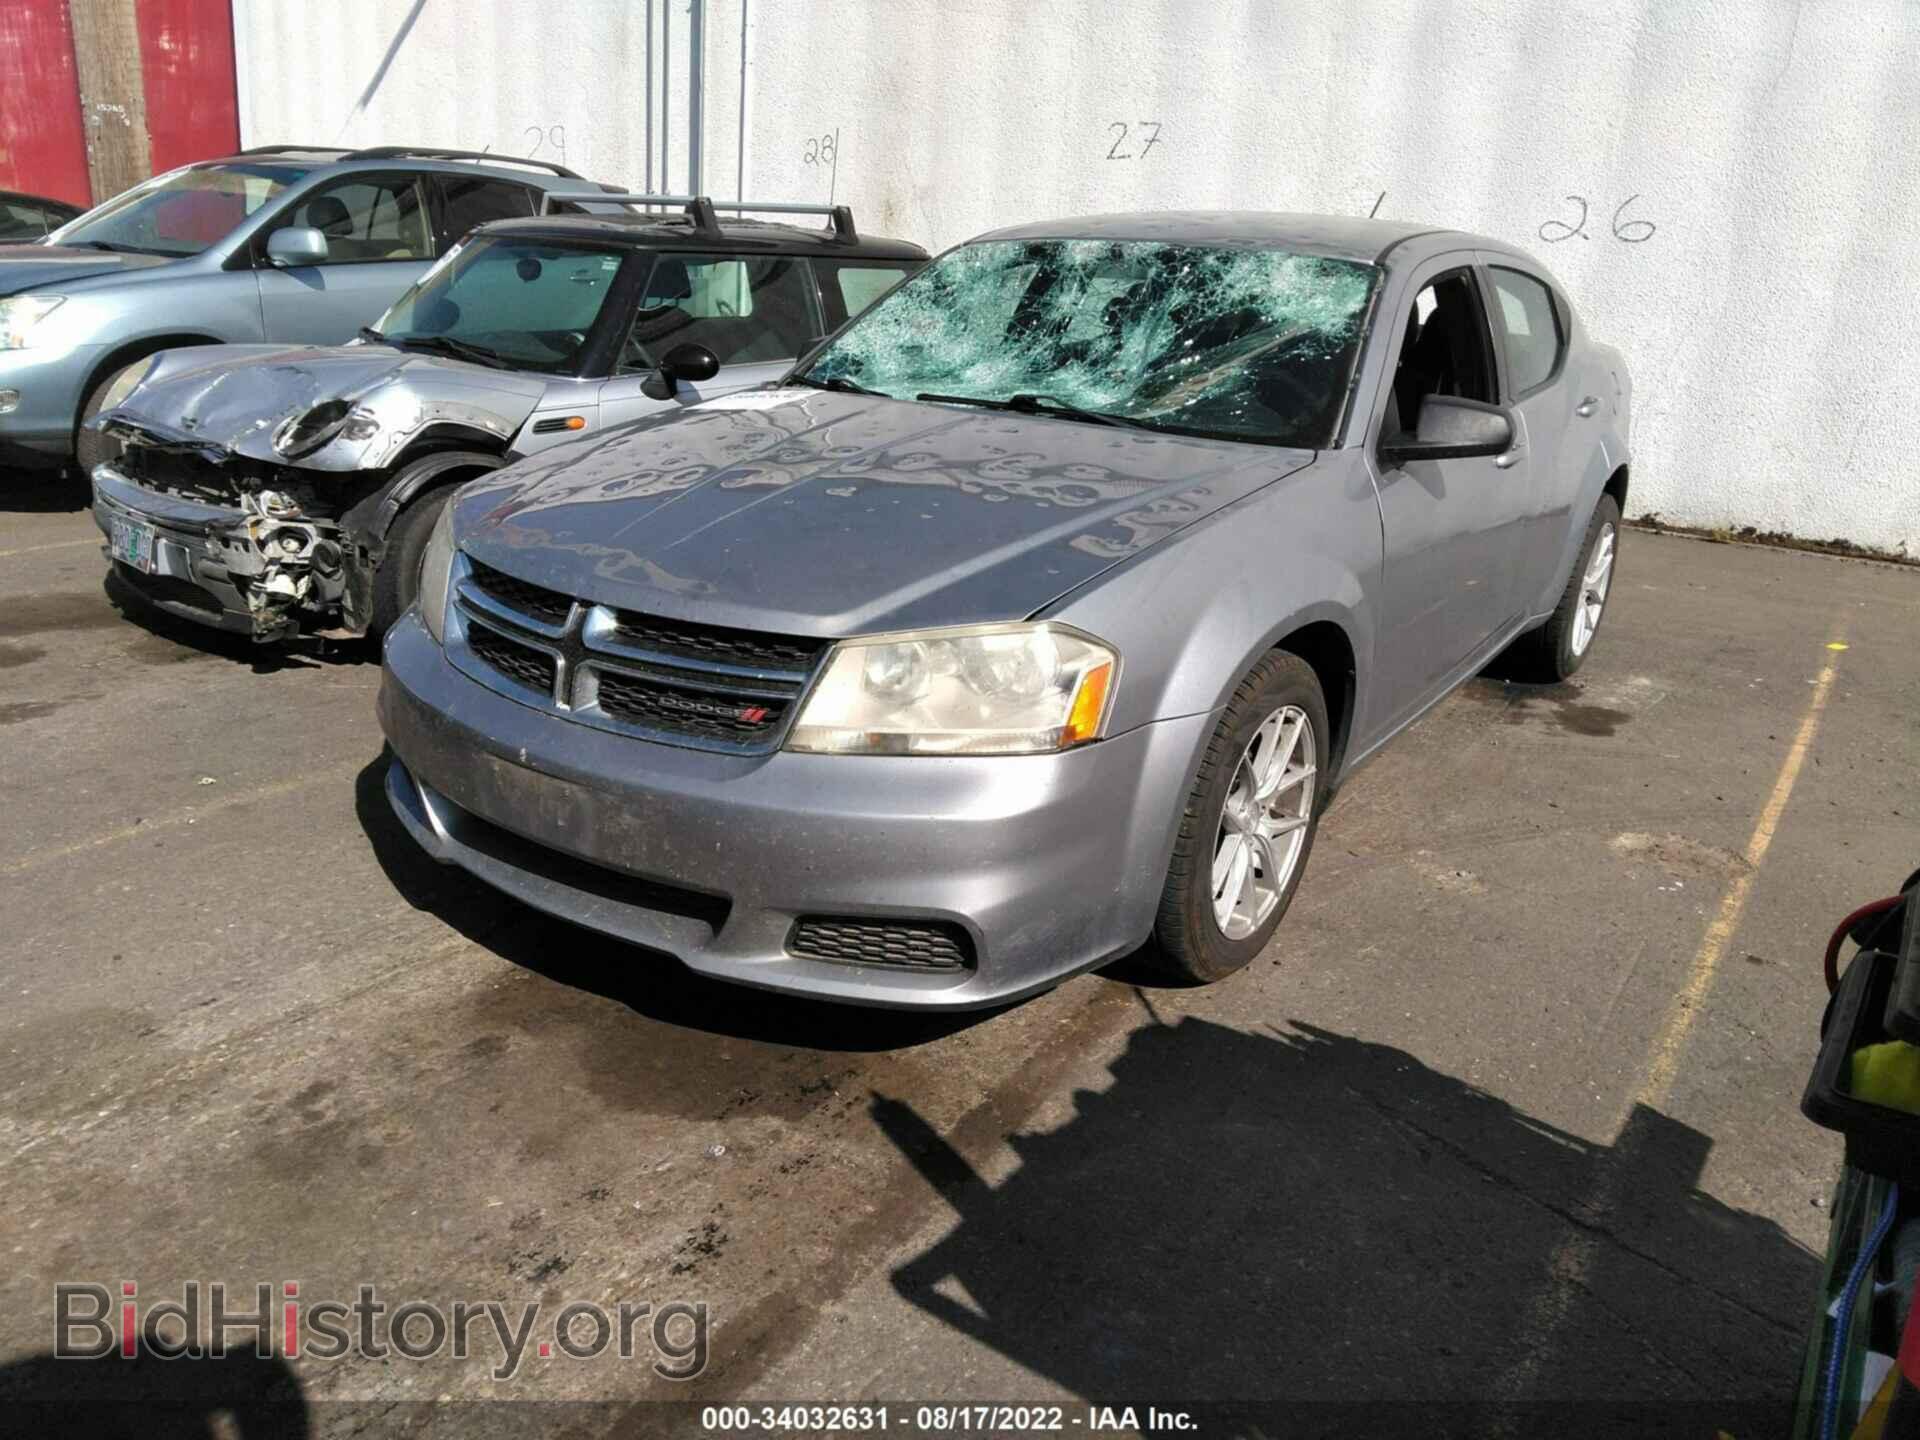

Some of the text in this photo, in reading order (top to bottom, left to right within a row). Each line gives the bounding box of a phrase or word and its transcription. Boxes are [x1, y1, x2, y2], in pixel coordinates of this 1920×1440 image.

[523, 124, 567, 166] 29
[804, 134, 834, 167] 28
[1106, 121, 1162, 160] 27
[1539, 193, 1656, 243] 26
[659, 696, 742, 717] DODGE
